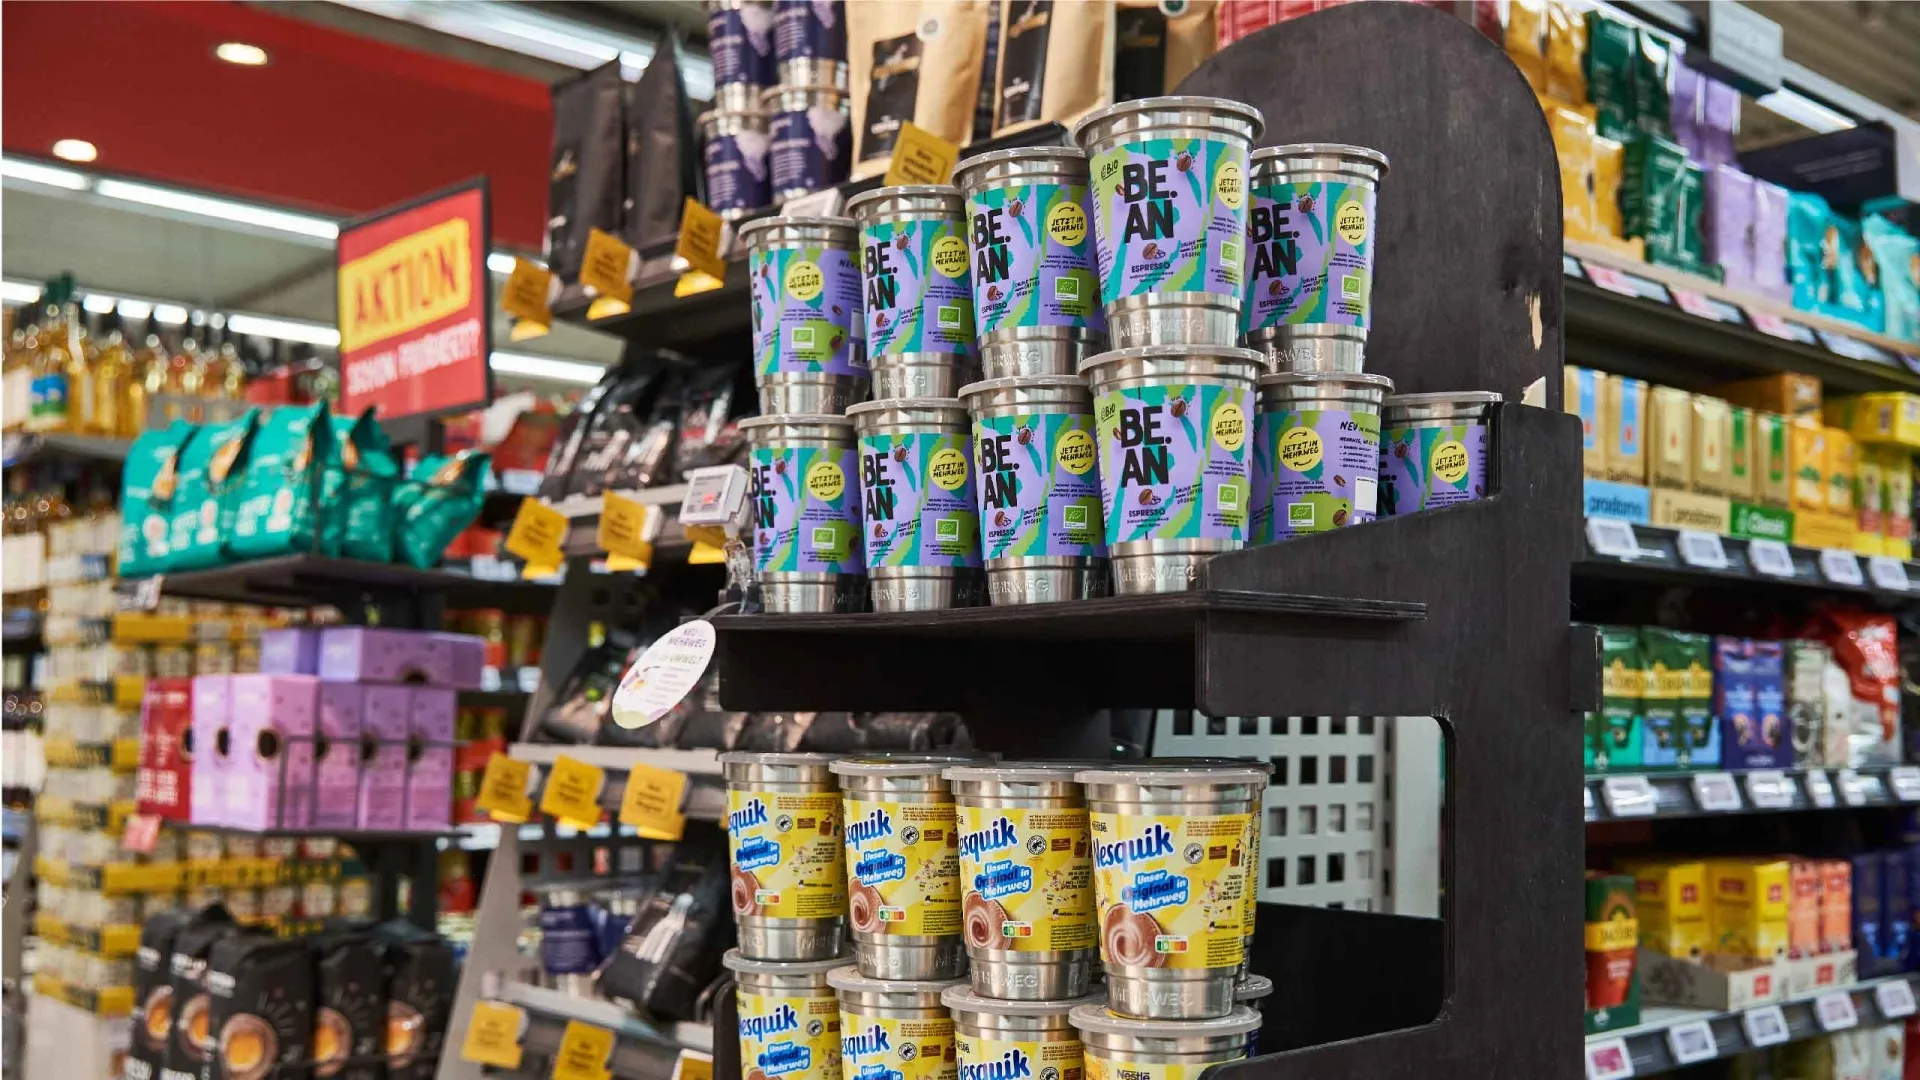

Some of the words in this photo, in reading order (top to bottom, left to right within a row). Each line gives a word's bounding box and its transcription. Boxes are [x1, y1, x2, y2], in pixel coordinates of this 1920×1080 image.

[1123, 160, 1178, 204] BE.
[1218, 178, 1237, 187] JETZT
[1051, 217, 1075, 227] JETZT
[1124, 200, 1174, 244] AN
[1251, 203, 1300, 244] BE.
[1339, 217, 1358, 225] JETZT
[973, 208, 1011, 251] BE.
[1051, 223, 1084, 233] MEHRWEG
[865, 241, 898, 279] BE.
[935, 256, 967, 265] MEHRWEG
[936, 250, 958, 259] JETZT
[1254, 239, 1297, 281] AN
[977, 244, 1009, 287] AN
[1131, 262, 1171, 273] ESPRESSO
[355, 239, 457, 334] AKTION
[867, 275, 896, 314] AN
[1259, 297, 1293, 308] ESPRESSO
[1120, 406, 1172, 448] BE.
[1215, 420, 1236, 429] JETZT
[1215, 427, 1243, 437] MEHRWEG
[1060, 446, 1085, 455] JETZT
[1282, 441, 1309, 454] JETZT
[981, 434, 1020, 474] BE.
[1060, 452, 1093, 462] MEHRWEG
[1282, 448, 1319, 460] MEHRWEG
[1435, 454, 1459, 466] JETZT
[864, 452, 896, 488] BE.
[933, 463, 956, 472] JETZT
[1121, 445, 1169, 488] AN
[1435, 460, 1466, 472] MEHRWEG
[933, 468, 965, 478] MEHRWEG
[811, 475, 831, 484] JETZT
[811, 480, 841, 489] MEHRWEG
[984, 471, 1017, 510] AN
[866, 486, 894, 522] AN
[1128, 508, 1166, 518] ESPRESSO
[988, 529, 1015, 538] ESPRESSO
[741, 854, 778, 869] Mehrweg
[865, 851, 886, 860] Unser
[895, 856, 903, 865] in
[986, 862, 1010, 874] Unser
[863, 867, 903, 884] Mehrweg
[976, 868, 1018, 888] Original
[1020, 868, 1030, 877] in
[1137, 871, 1166, 885] Unser
[984, 879, 1030, 898] Mehrweg
[1124, 879, 1174, 901] Original
[1177, 878, 1186, 889] in
[1134, 890, 1186, 911] Mehrweg
[769, 1043, 792, 1054] Unser
[767, 1059, 809, 1075] Mehrweg
[862, 1065, 883, 1074] Unser
[1116, 1069, 1151, 1080] Nestlé
